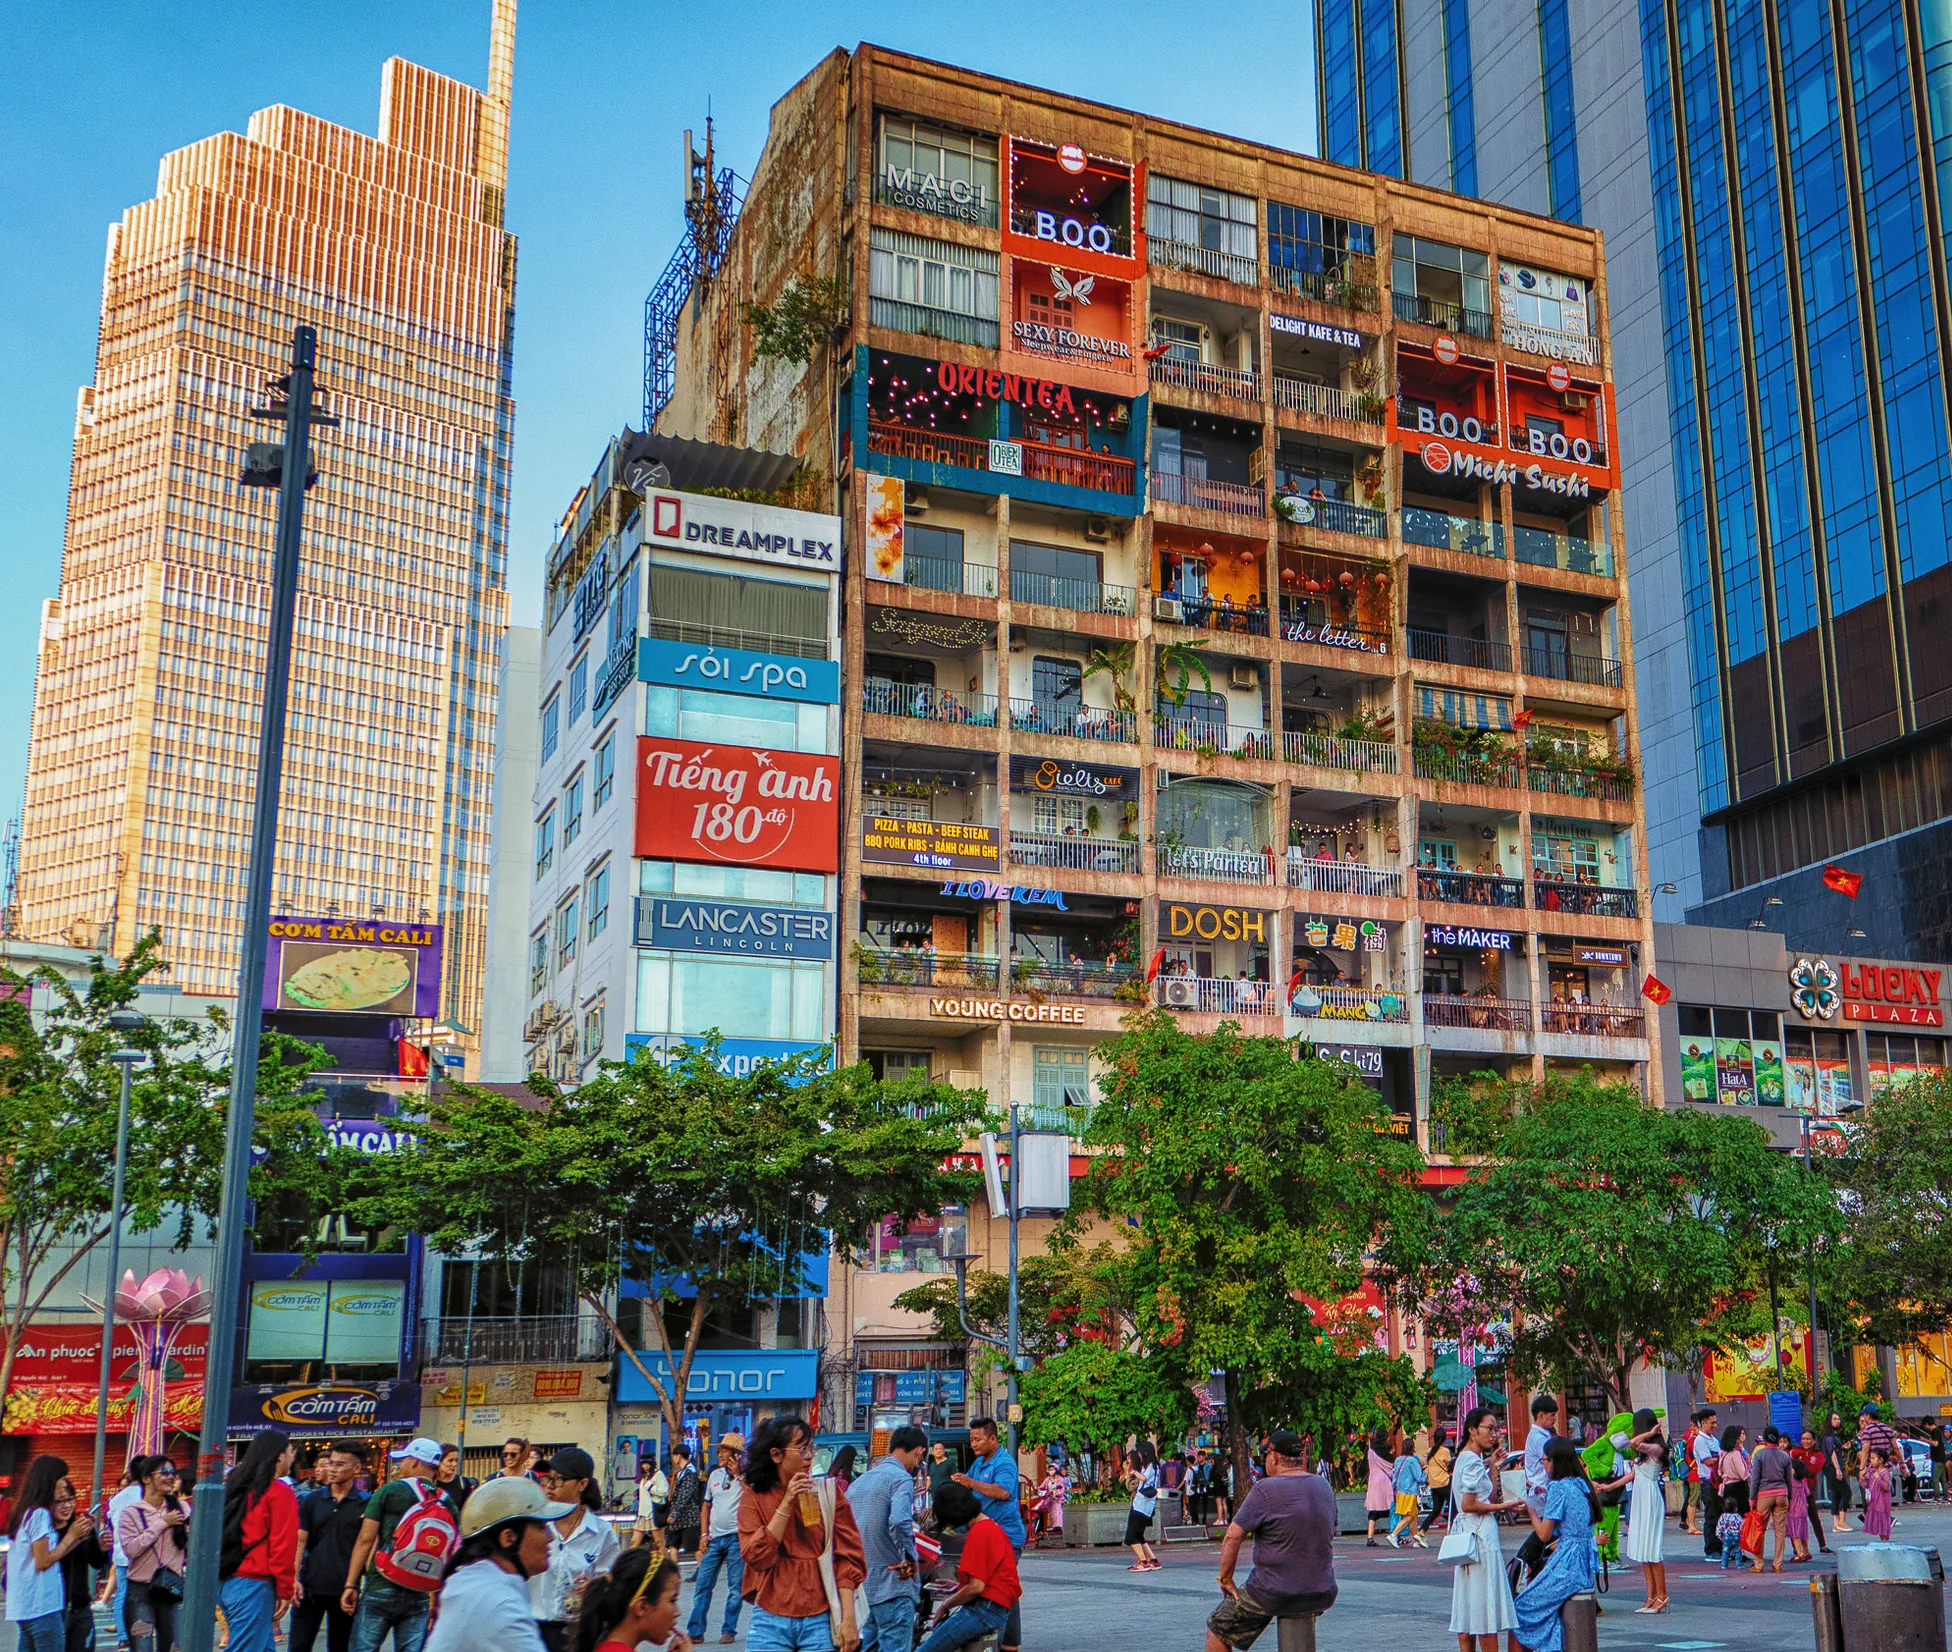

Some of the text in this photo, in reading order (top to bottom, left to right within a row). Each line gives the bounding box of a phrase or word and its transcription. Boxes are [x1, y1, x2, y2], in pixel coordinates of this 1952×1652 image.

[887, 163, 987, 210] MACI
[893, 191, 979, 221] COSMETICS
[1036, 210, 1111, 252] BOO
[1013, 320, 1131, 359] SEXY FOREVER
[1270, 313, 1361, 348] DELIGHT KAFE & TEA
[938, 361, 1076, 414] ORIENTEA
[1417, 406, 1482, 443] BOO
[1528, 428, 1593, 463] BOO
[1453, 450, 1589, 498] Michi Sushi
[685, 521, 834, 562] DREAMPLEX
[1287, 621, 1387, 654] the letter 6
[739, 661, 807, 692] spa
[646, 749, 748, 803] Tiếng
[691, 802, 764, 843] 180
[874, 818, 898, 832] PIZZA
[907, 821, 933, 836] PASTA
[941, 824, 961, 838] BEEF
[962, 827, 989, 841] STEAK
[864, 834, 882, 848] BBQ
[883, 836, 906, 850] PORK
[907, 838, 927, 852] RIBS
[935, 838, 957, 854] BÁNH
[958, 843, 980, 857] CANH
[981, 844, 998, 861] GHẸ
[913, 853, 952, 867] 4th floor
[940, 877, 1069, 911] I LOVE KEM
[269, 919, 432, 946] CƠM TẤM CALI
[661, 904, 829, 940] LANCASTER
[1170, 905, 1264, 943] DOSH
[1431, 926, 1511, 950] the MAKER
[695, 936, 793, 952] LINCOLN
[1840, 963, 1943, 1005] LUCKY
[930, 998, 1086, 1024] YOUNG COFFEE
[1852, 1006, 1937, 1024] PLAZA
[326, 1430, 344, 1438] RICE
[338, 1414, 375, 1425] CALI
